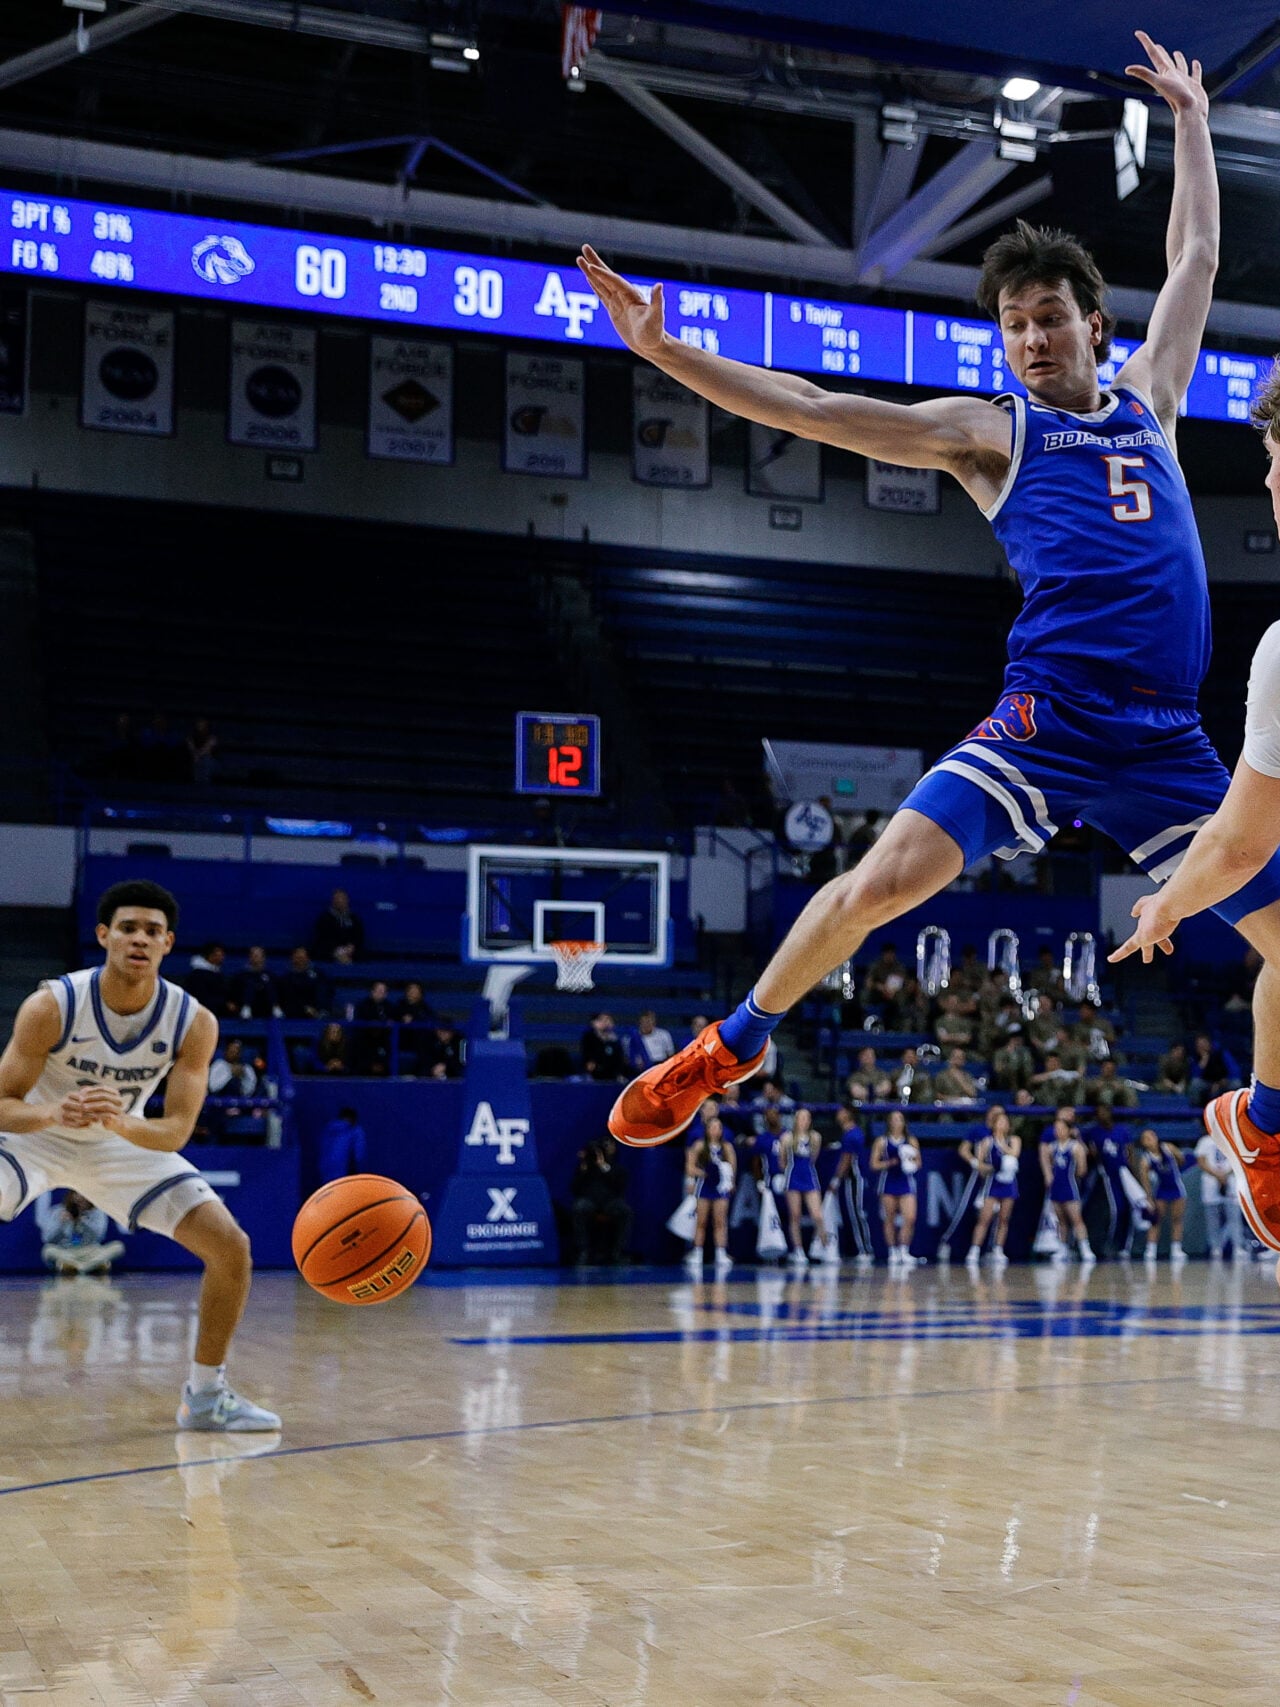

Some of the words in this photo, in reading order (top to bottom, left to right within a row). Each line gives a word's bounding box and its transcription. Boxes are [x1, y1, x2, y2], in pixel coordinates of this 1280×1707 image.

[12, 200, 50, 231] 3PT
[53, 206, 71, 234] %
[12, 239, 37, 269] FG
[40, 243, 58, 272] %
[295, 244, 346, 299] 60
[374, 245, 426, 277] 13:30
[380, 283, 417, 312] 2ND
[454, 265, 503, 319] 30
[534, 271, 599, 339] AF
[679, 290, 712, 318] 3PT
[713, 294, 729, 321] %
[804, 303, 843, 327] Taylor
[950, 322, 993, 346] Cooper
[992, 347, 1003, 368] 2
[993, 370, 1003, 391] 2
[1042, 430, 1113, 451] BOISE
[1101, 454, 1152, 522] 5
[547, 745, 583, 787] 12
[67, 1056, 99, 1075] AIR
[465, 1101, 530, 1165] AF
[486, 1187, 518, 1222] X
